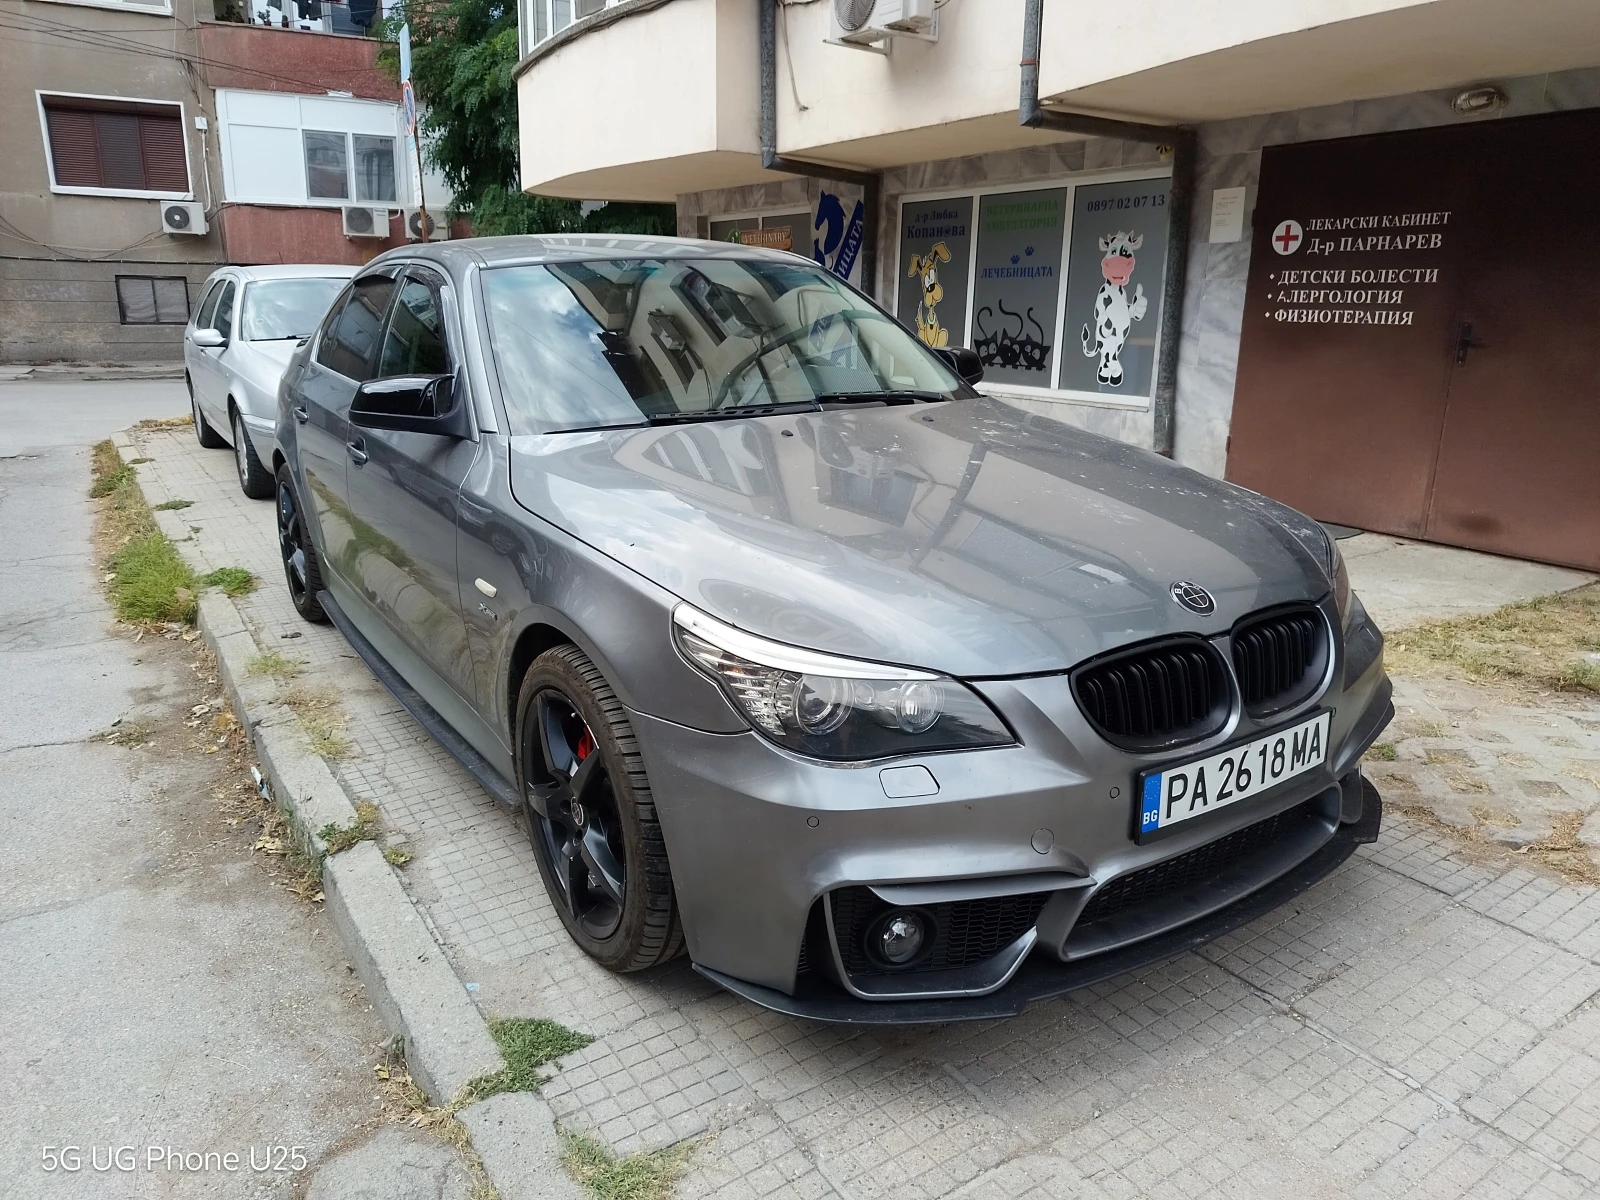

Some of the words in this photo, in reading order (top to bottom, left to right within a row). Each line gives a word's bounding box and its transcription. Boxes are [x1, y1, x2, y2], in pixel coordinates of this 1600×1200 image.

[987, 200, 1058, 216] ВЕТЕРИНАРНА
[1087, 198, 1115, 212] 0897
[1117, 197, 1131, 210] 02
[1133, 195, 1148, 208] 07
[1151, 194, 1165, 207] 13
[930, 209, 958, 221] Любка
[1306, 215, 1379, 231] ЛЕКАРСКИ
[1381, 211, 1452, 228] КАБИНЕТ
[986, 217, 1058, 232] АМБУЛАТОРИЯ
[744, 231, 787, 244] VETERINARY
[1306, 238, 1335, 256] Д-р
[1338, 233, 1443, 252] ПАРНАРЕВ
[836, 219, 864, 276] ИЦАТА
[980, 266, 1053, 280] ЛЕЧЕБНИЦАТА
[1277, 270, 1346, 286] ДЕТСКИ
[1350, 268, 1439, 284] БОЛЕСТИ
[1276, 290, 1404, 304] АЛЕРГОЛОГИЯ
[1274, 309, 1415, 325] ФИЗИОТЕРАПИЯ
[1143, 810, 1158, 825] BG
